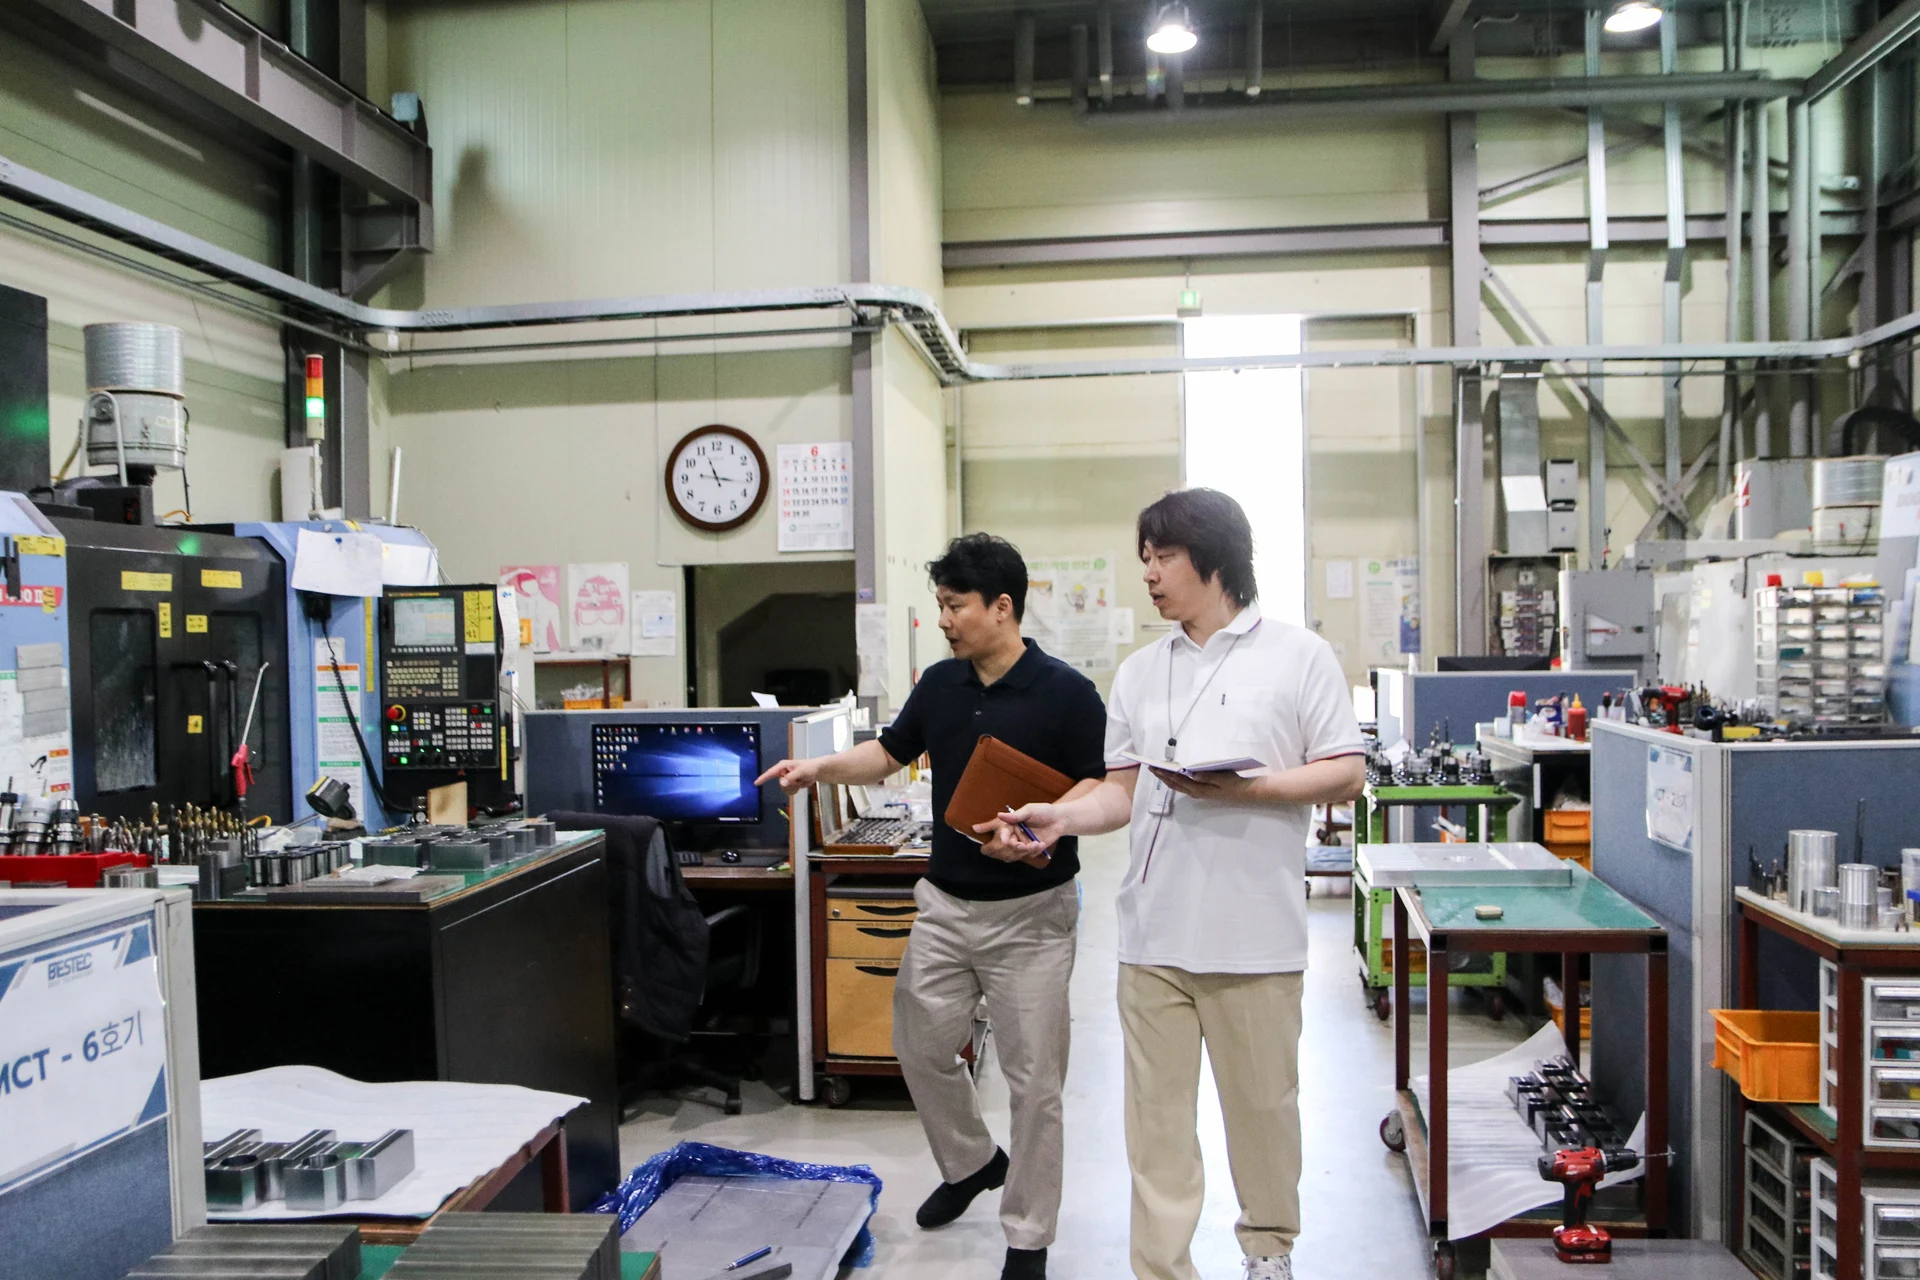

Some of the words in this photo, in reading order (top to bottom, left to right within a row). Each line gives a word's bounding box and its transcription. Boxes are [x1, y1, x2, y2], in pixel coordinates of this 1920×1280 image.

[697, 446, 706, 456] 11
[712, 441, 722, 451] 12
[731, 445, 735, 455] 1
[811, 446, 819, 457] 6
[685, 458, 696, 468] 10
[740, 455, 748, 466] 2
[681, 473, 689, 484] 9
[746, 471, 753, 483] 3
[686, 489, 694, 500] 8
[740, 488, 747, 498] 4
[699, 501, 705, 512] 7
[714, 505, 721, 516] 6
[730, 500, 737, 511] 5
[48, 952, 92, 980] BESTEC
[83, 1010, 144, 1063] 6호기
